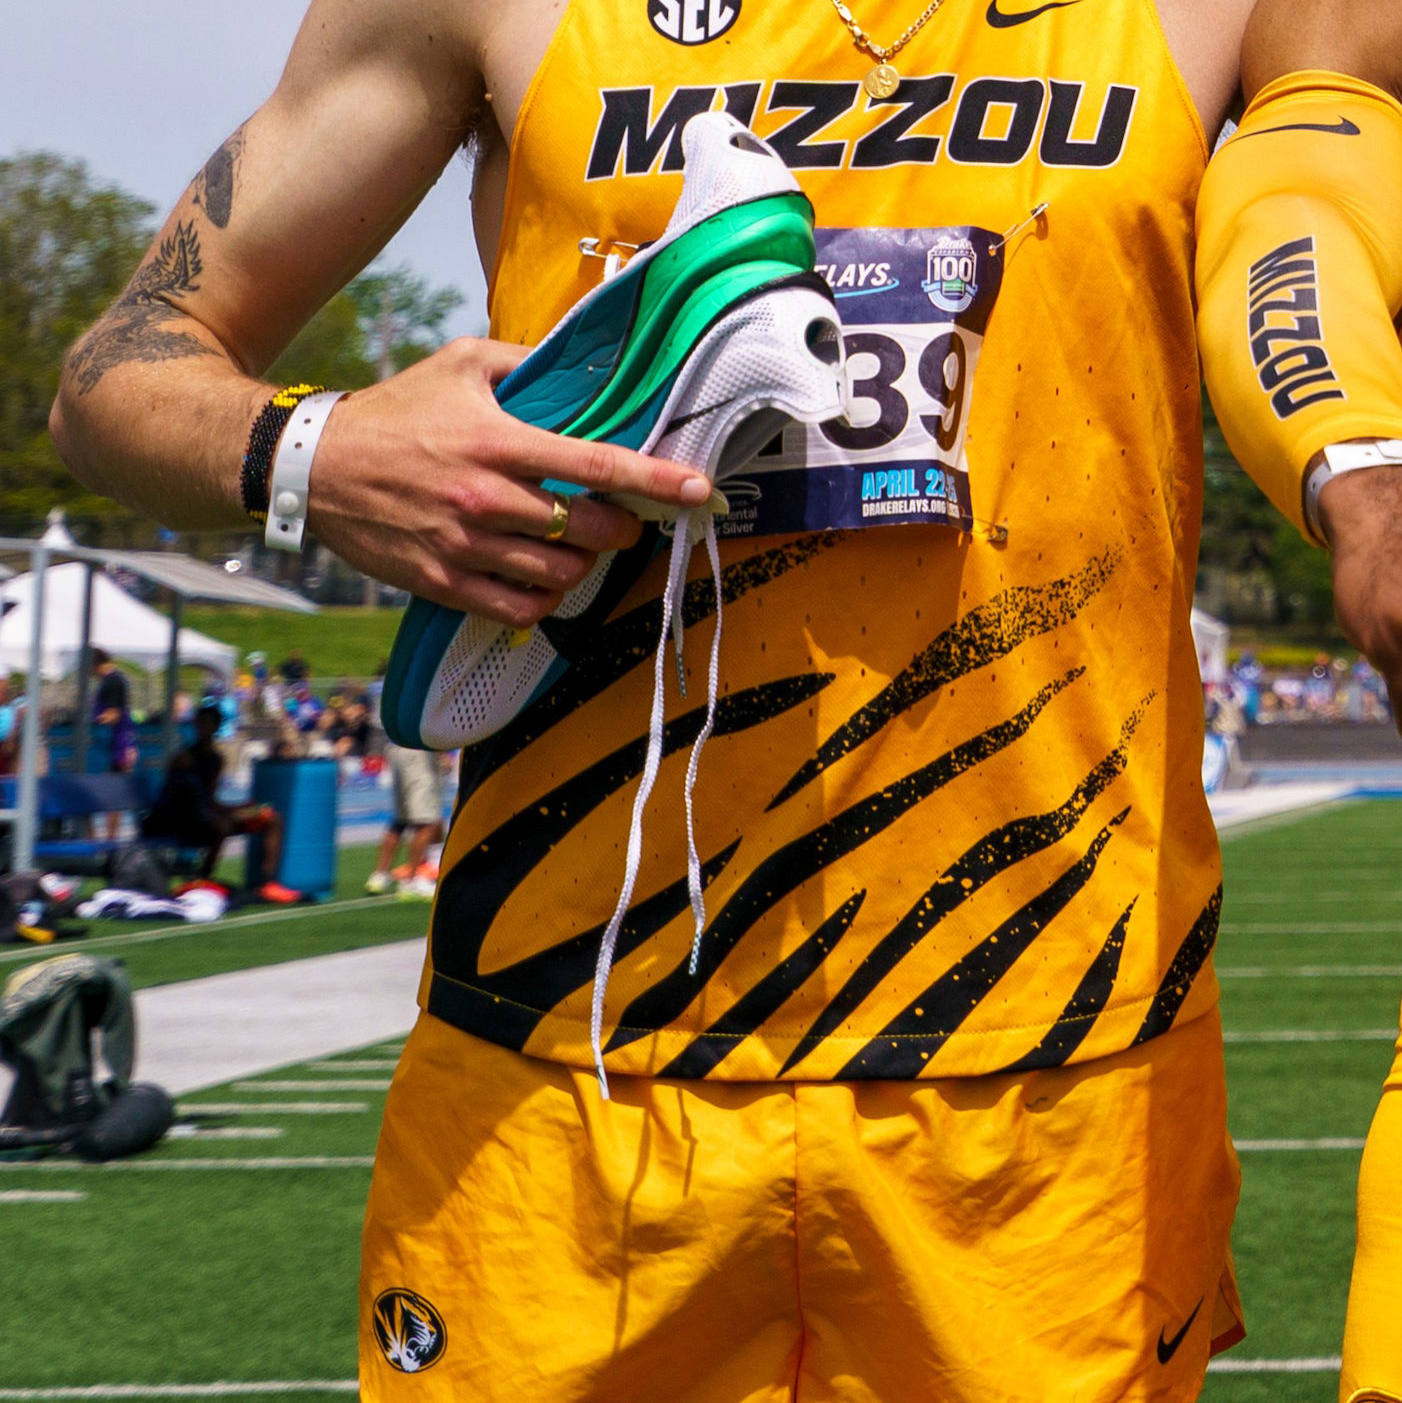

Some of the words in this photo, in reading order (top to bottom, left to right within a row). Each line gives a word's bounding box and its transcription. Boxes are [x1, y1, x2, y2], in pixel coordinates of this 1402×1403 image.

[814, 262, 890, 288] LAYS
[933, 256, 972, 283] 100
[1247, 234, 1348, 422] MIZZOU
[818, 331, 966, 451] 39
[861, 468, 920, 501] APRIL
[862, 499, 946, 517] DRAKERELAYS.ORG
